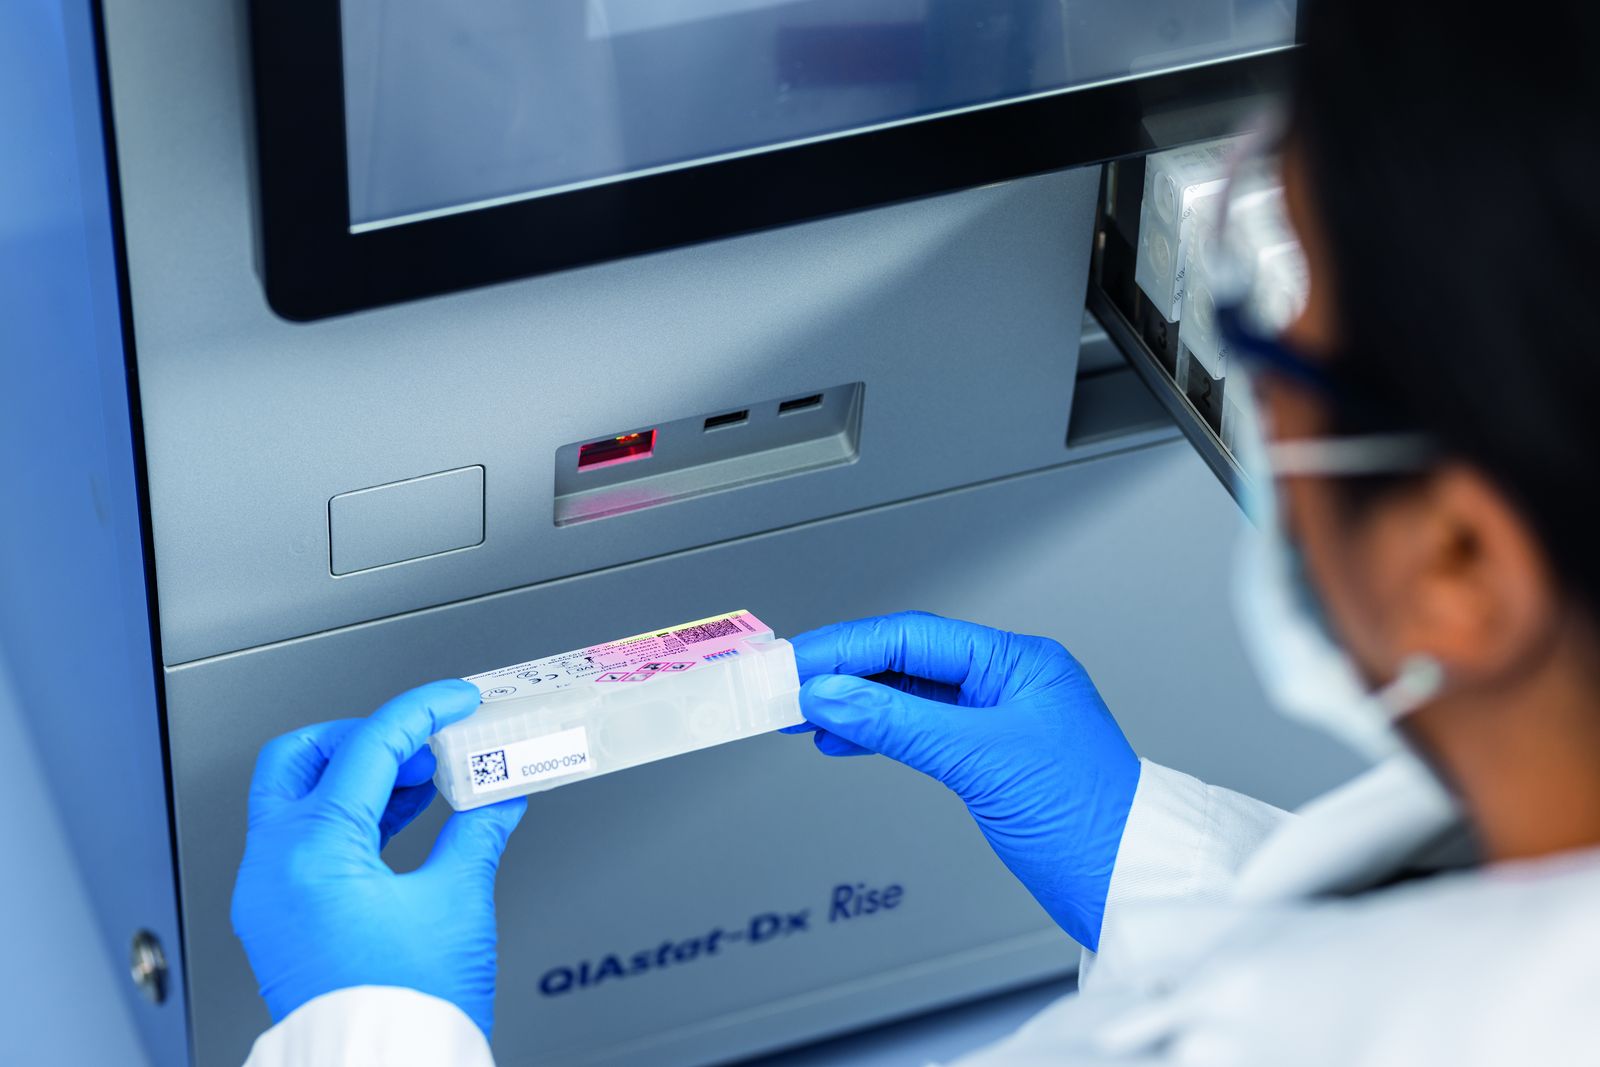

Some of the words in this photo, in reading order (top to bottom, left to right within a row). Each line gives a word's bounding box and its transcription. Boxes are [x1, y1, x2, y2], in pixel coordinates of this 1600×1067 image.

[521, 752, 586, 777] K50-00003
[537, 908, 811, 998] QIAstat-Dx
[827, 881, 905, 925] Rise
